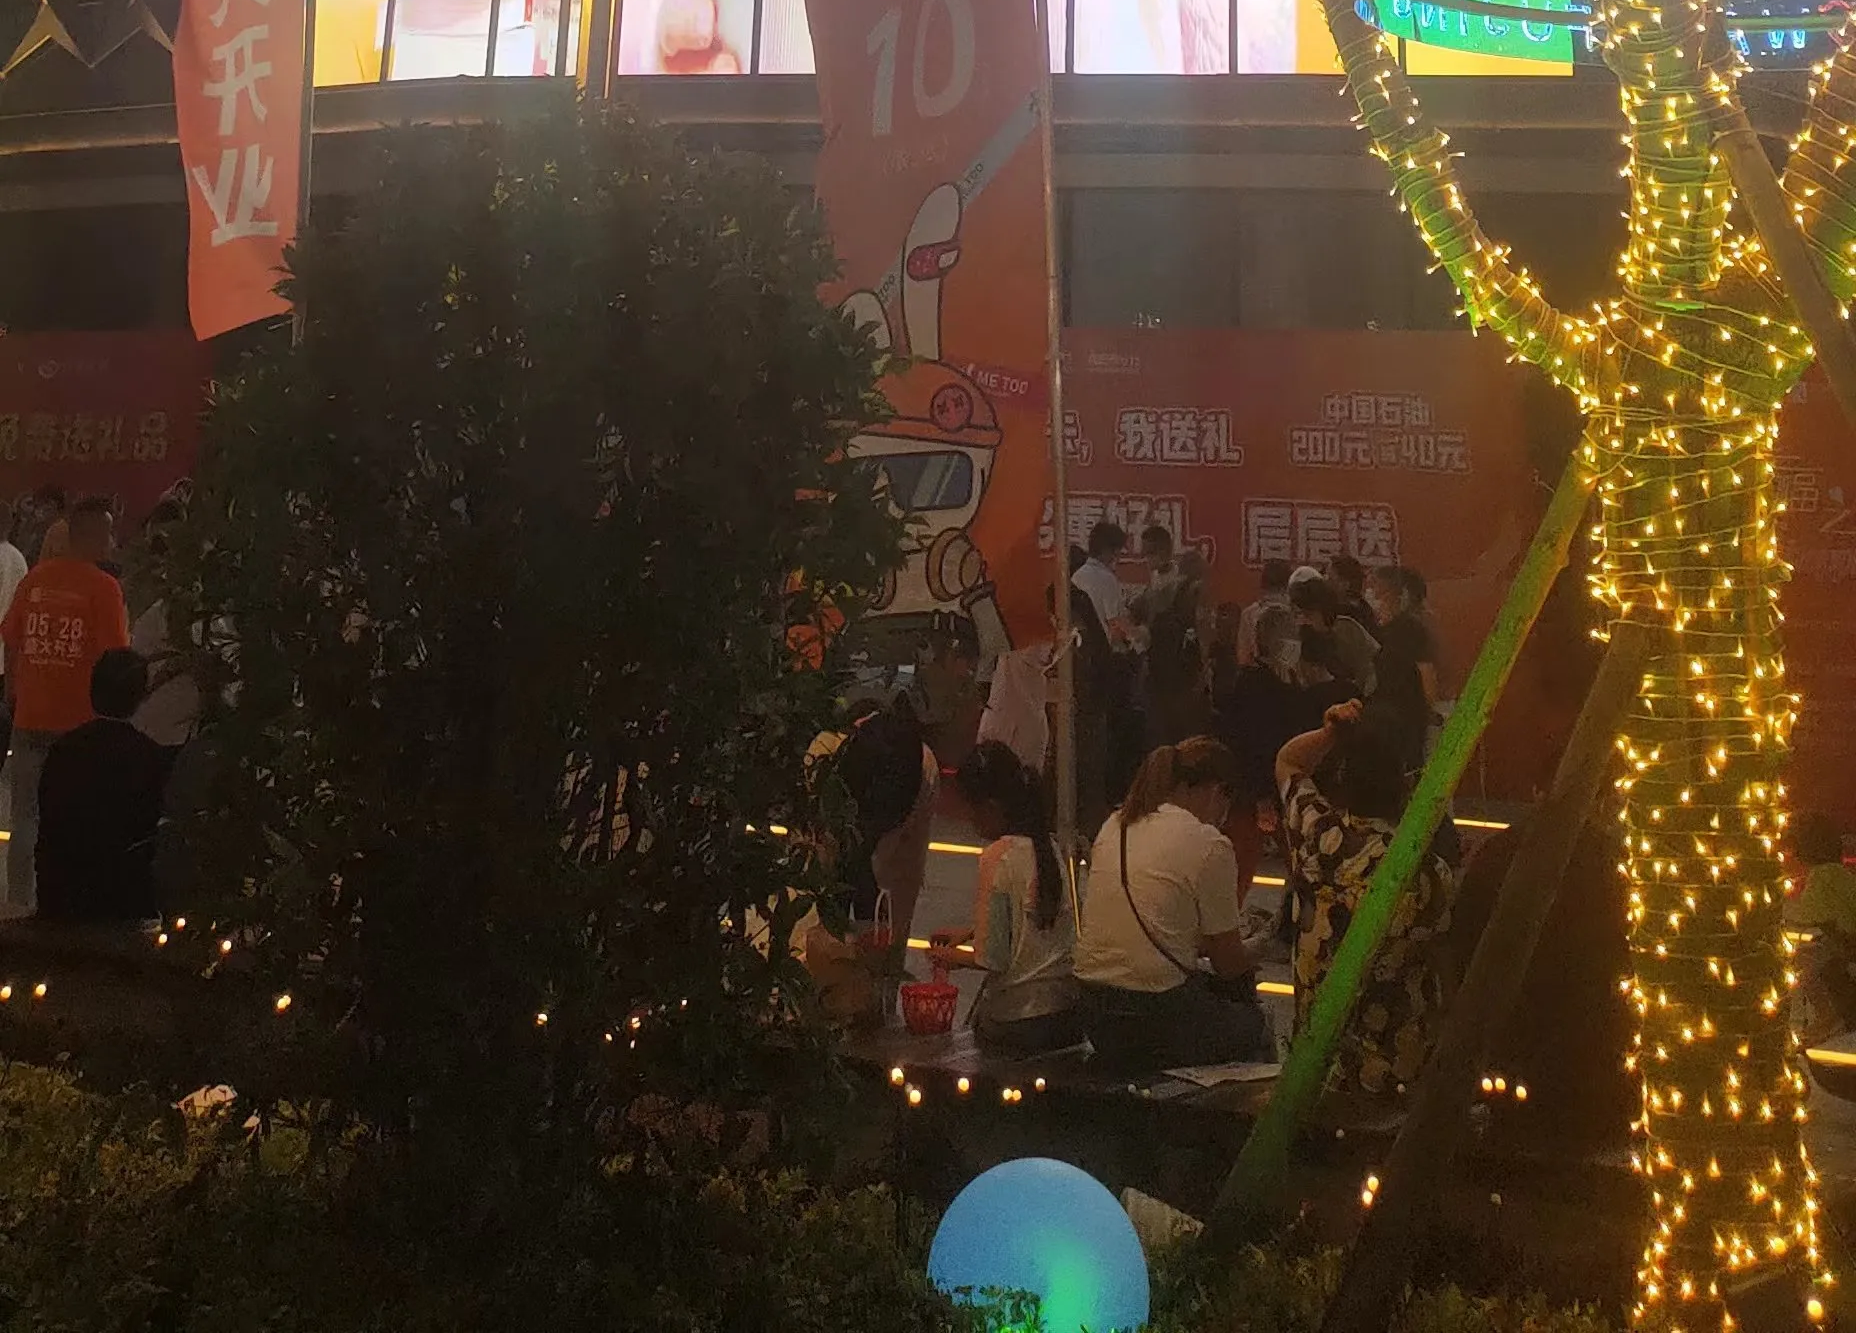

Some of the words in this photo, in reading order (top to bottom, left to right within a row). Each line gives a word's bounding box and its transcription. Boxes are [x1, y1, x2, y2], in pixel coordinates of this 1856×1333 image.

[977, 369, 1000, 387] ME
[1002, 372, 1029, 396] TOO
[1325, 393, 1431, 426] 中国石油
